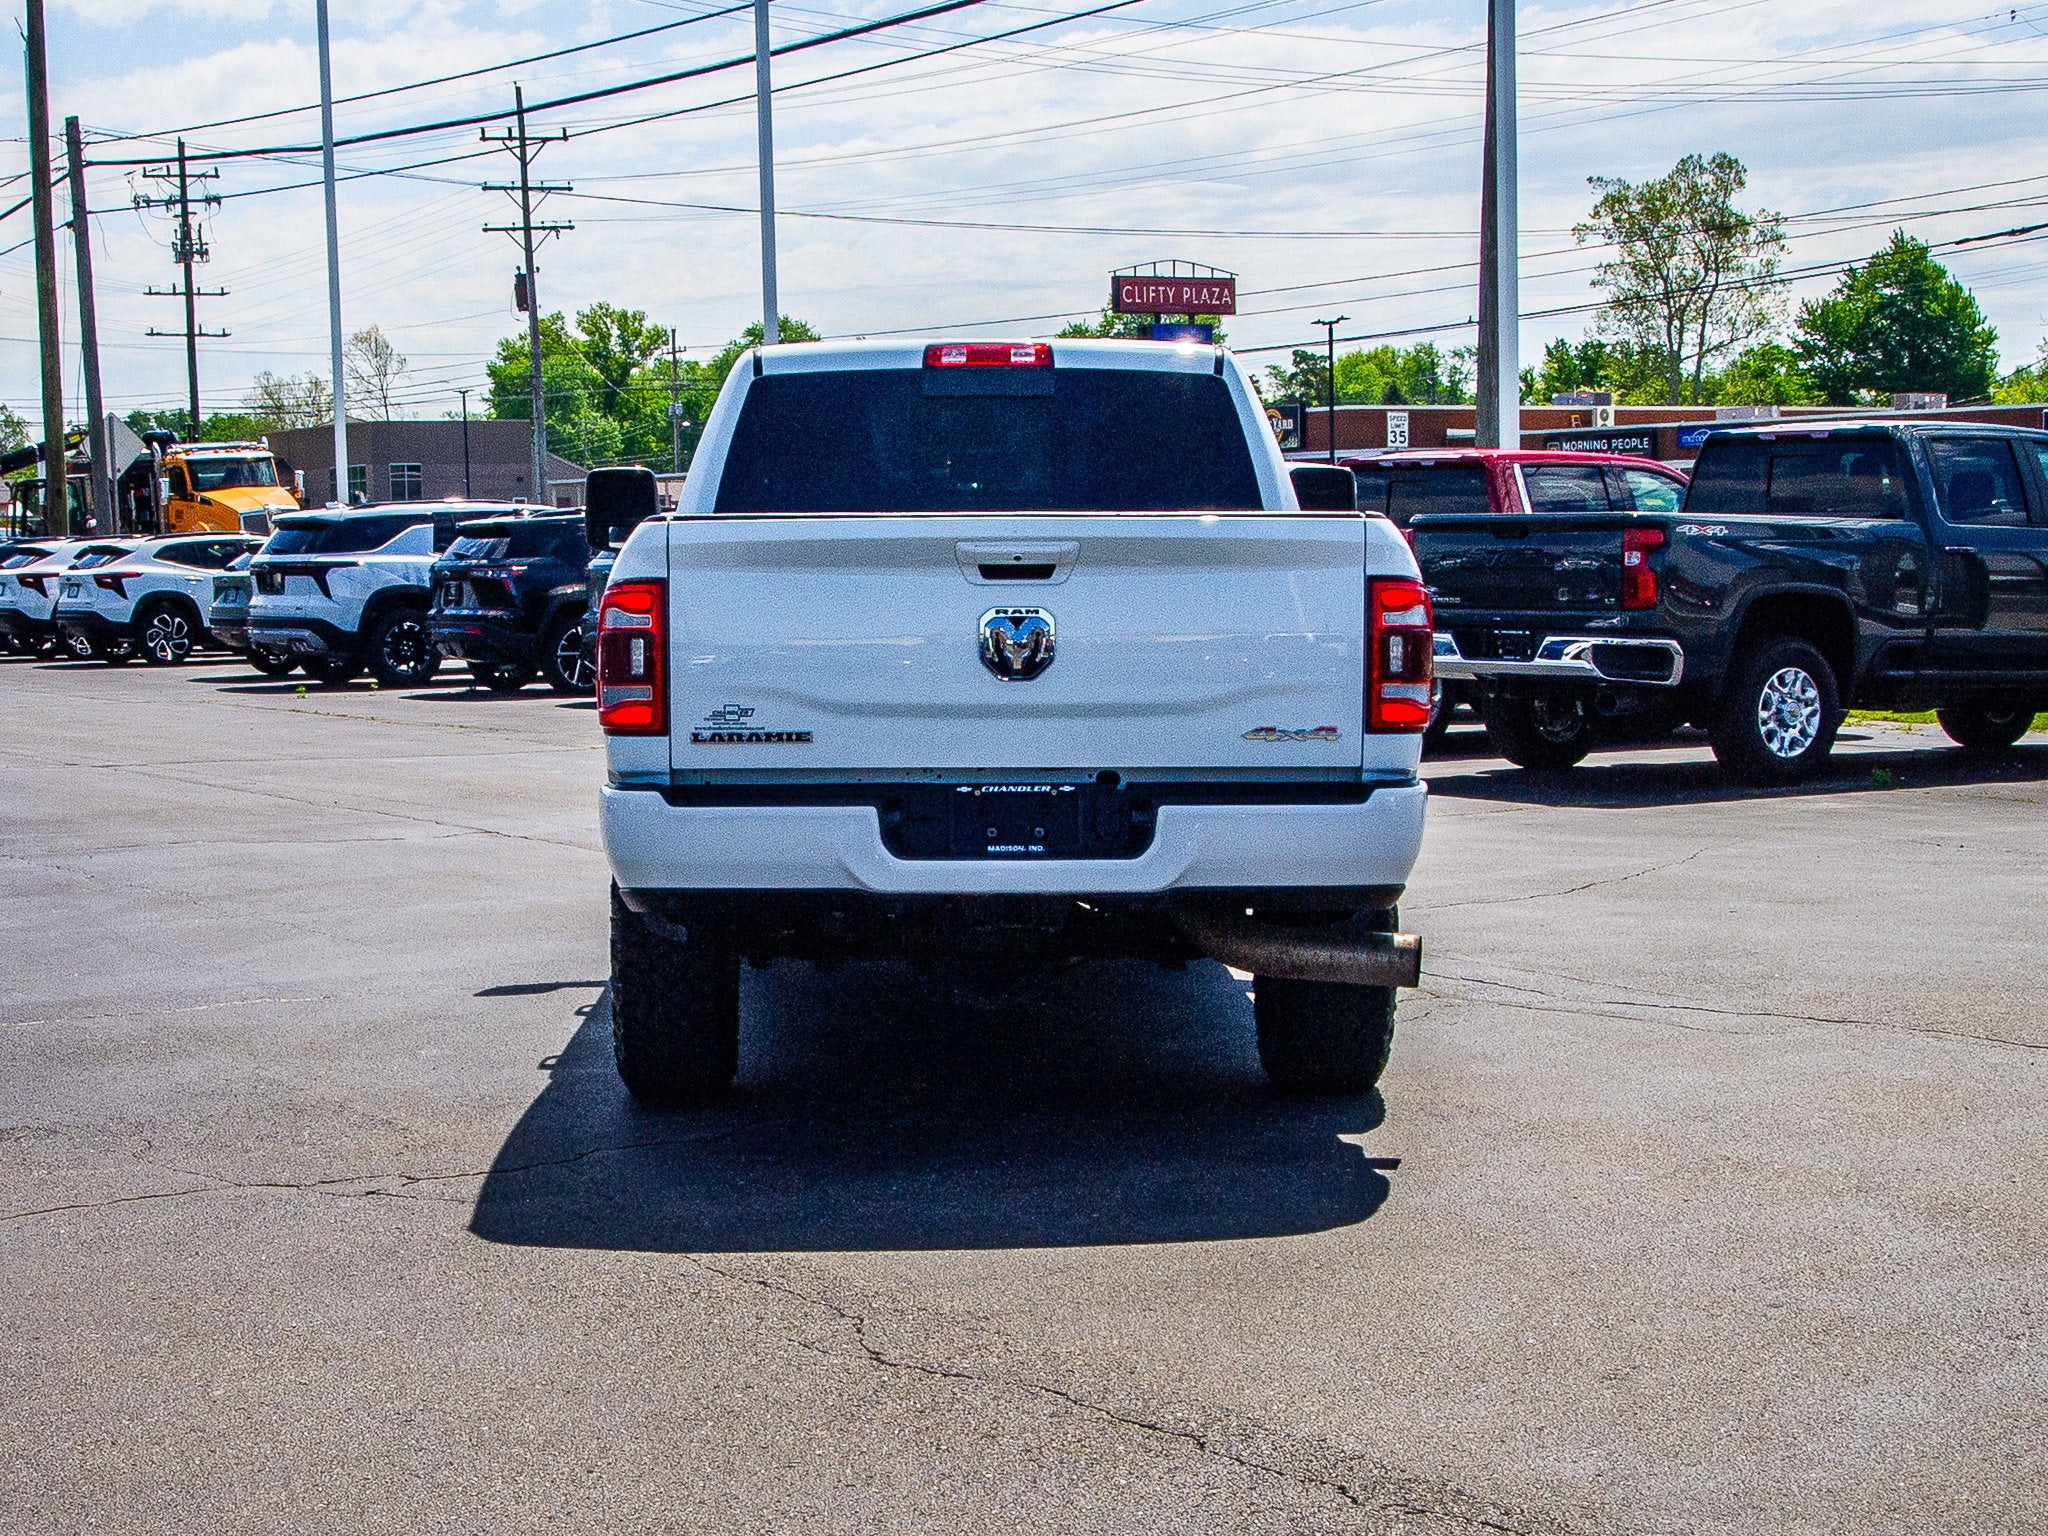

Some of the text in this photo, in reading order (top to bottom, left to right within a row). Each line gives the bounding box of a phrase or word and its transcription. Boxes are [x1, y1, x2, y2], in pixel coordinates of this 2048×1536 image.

[1122, 286, 1231, 305] CLIFTY PLAZA
[1390, 430, 1407, 444] 35
[1562, 437, 1649, 451] MORNING PEOPLE
[690, 731, 813, 743] LARAMIE
